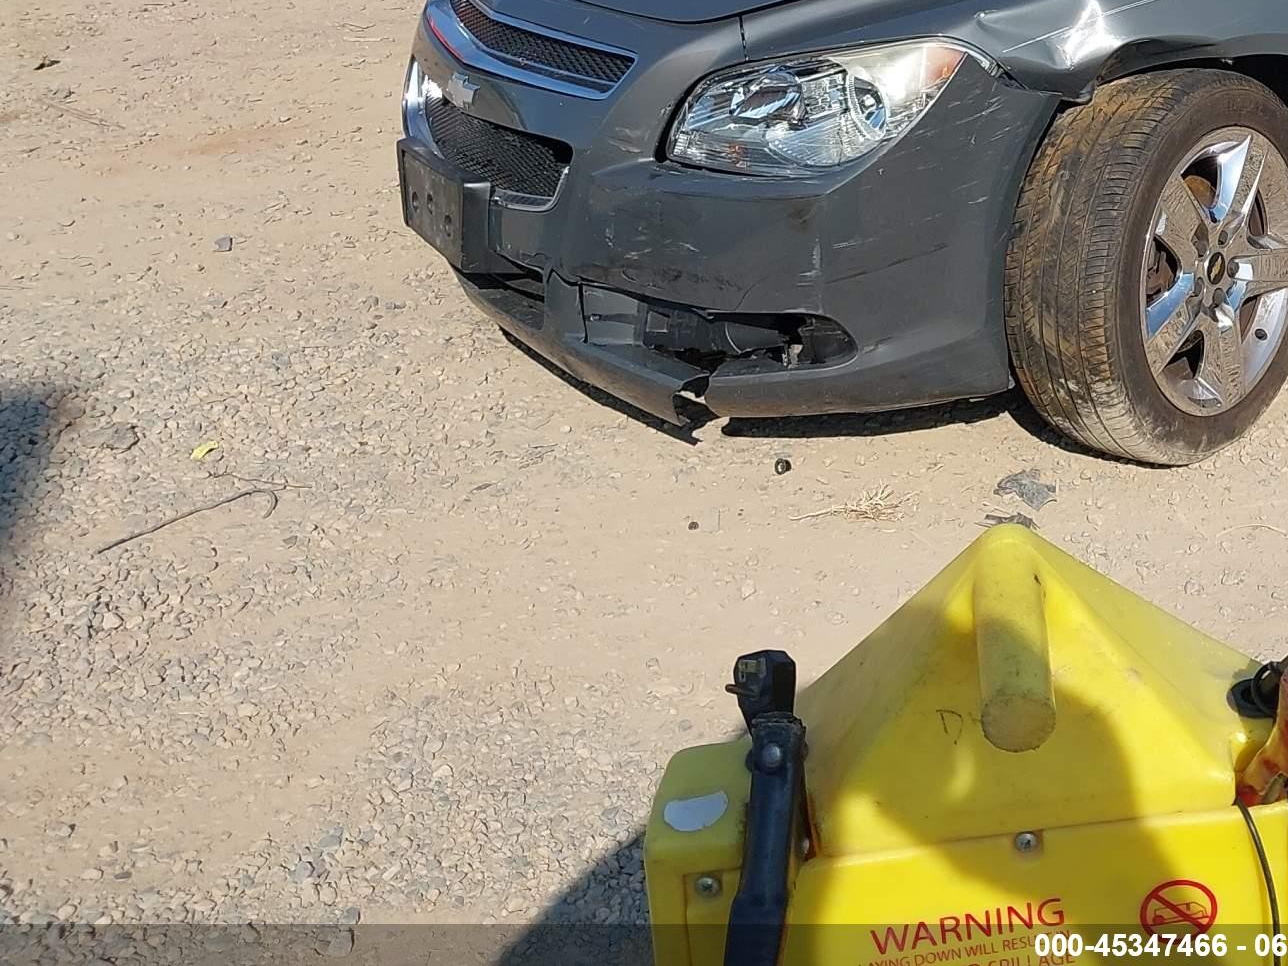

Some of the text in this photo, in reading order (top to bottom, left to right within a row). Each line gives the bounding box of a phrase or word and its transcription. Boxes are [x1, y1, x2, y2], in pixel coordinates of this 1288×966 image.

[869, 898, 1066, 955] WARNING
[914, 948, 961, 966] DOWN
[965, 942, 998, 958] WILL
